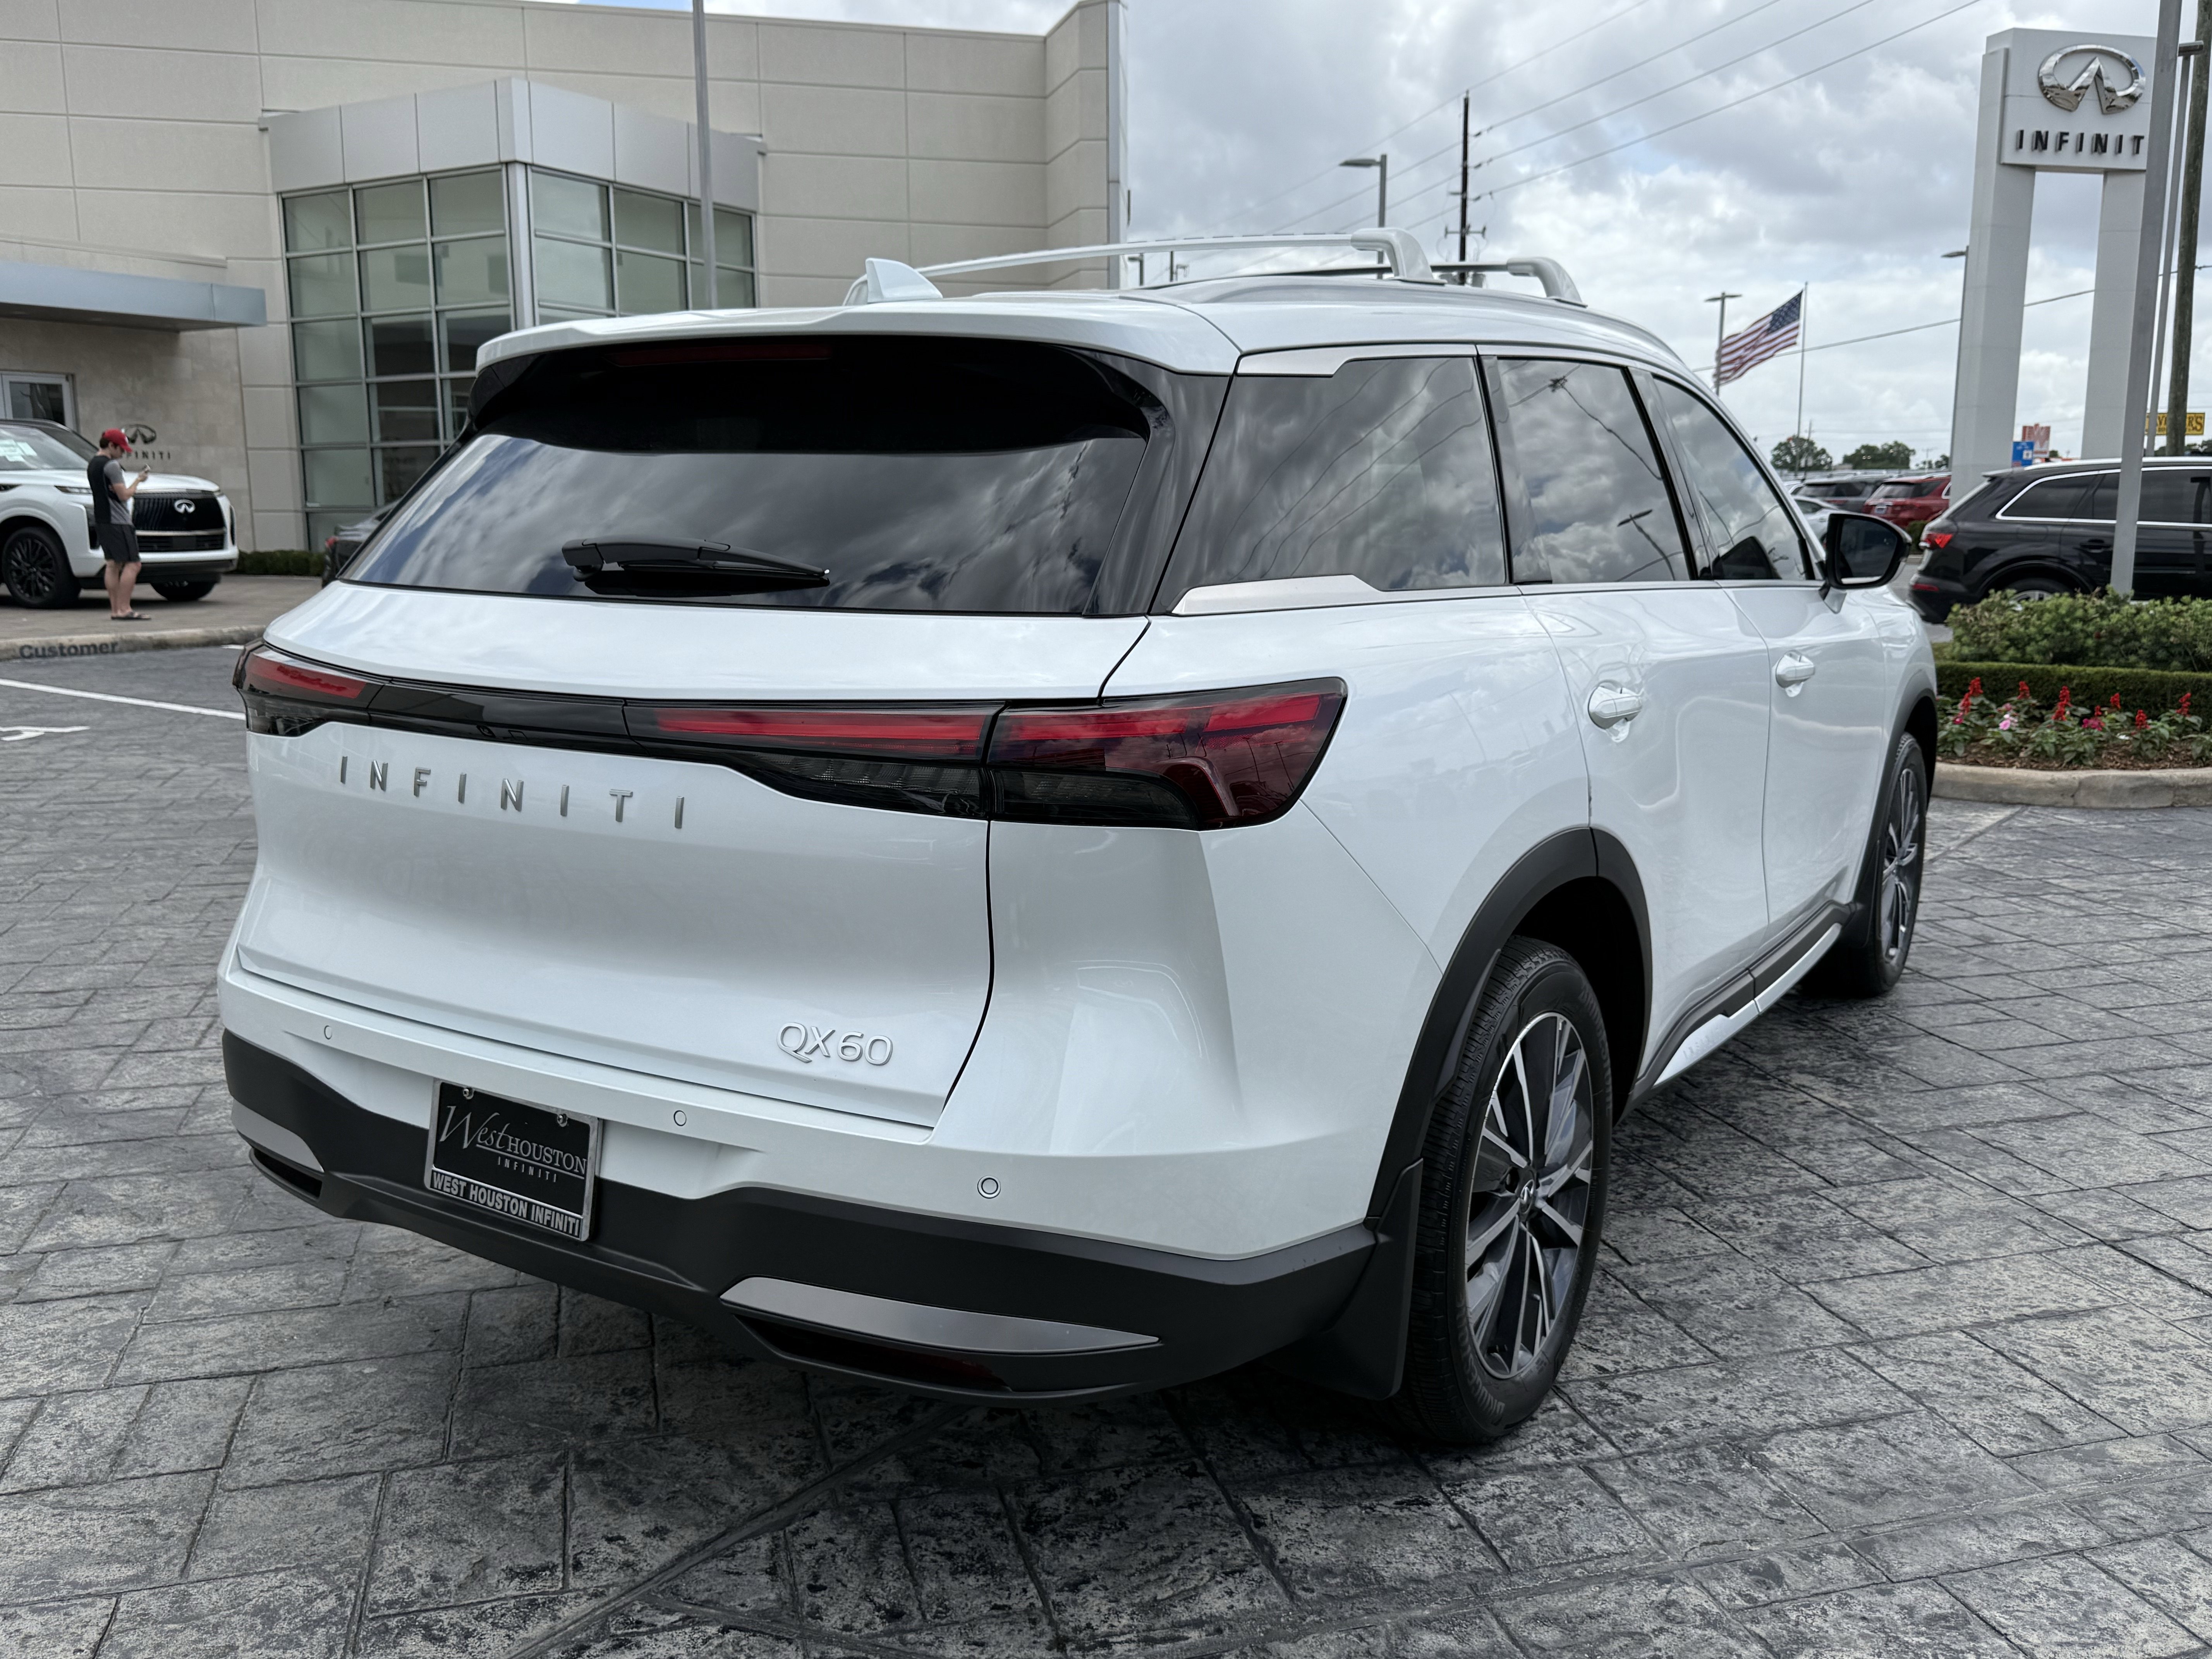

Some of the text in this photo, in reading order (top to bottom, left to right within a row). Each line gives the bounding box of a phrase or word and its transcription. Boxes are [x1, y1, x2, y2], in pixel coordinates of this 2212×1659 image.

[2016, 129, 2145, 155] INFINIT
[19, 641, 118, 659] Customer
[340, 755, 685, 829] INFINITI
[777, 1022, 893, 1066] QX60
[498, 1156, 557, 1183] INFINITI
[433, 1171, 580, 1237] WEST HOUSTON INFINITI
